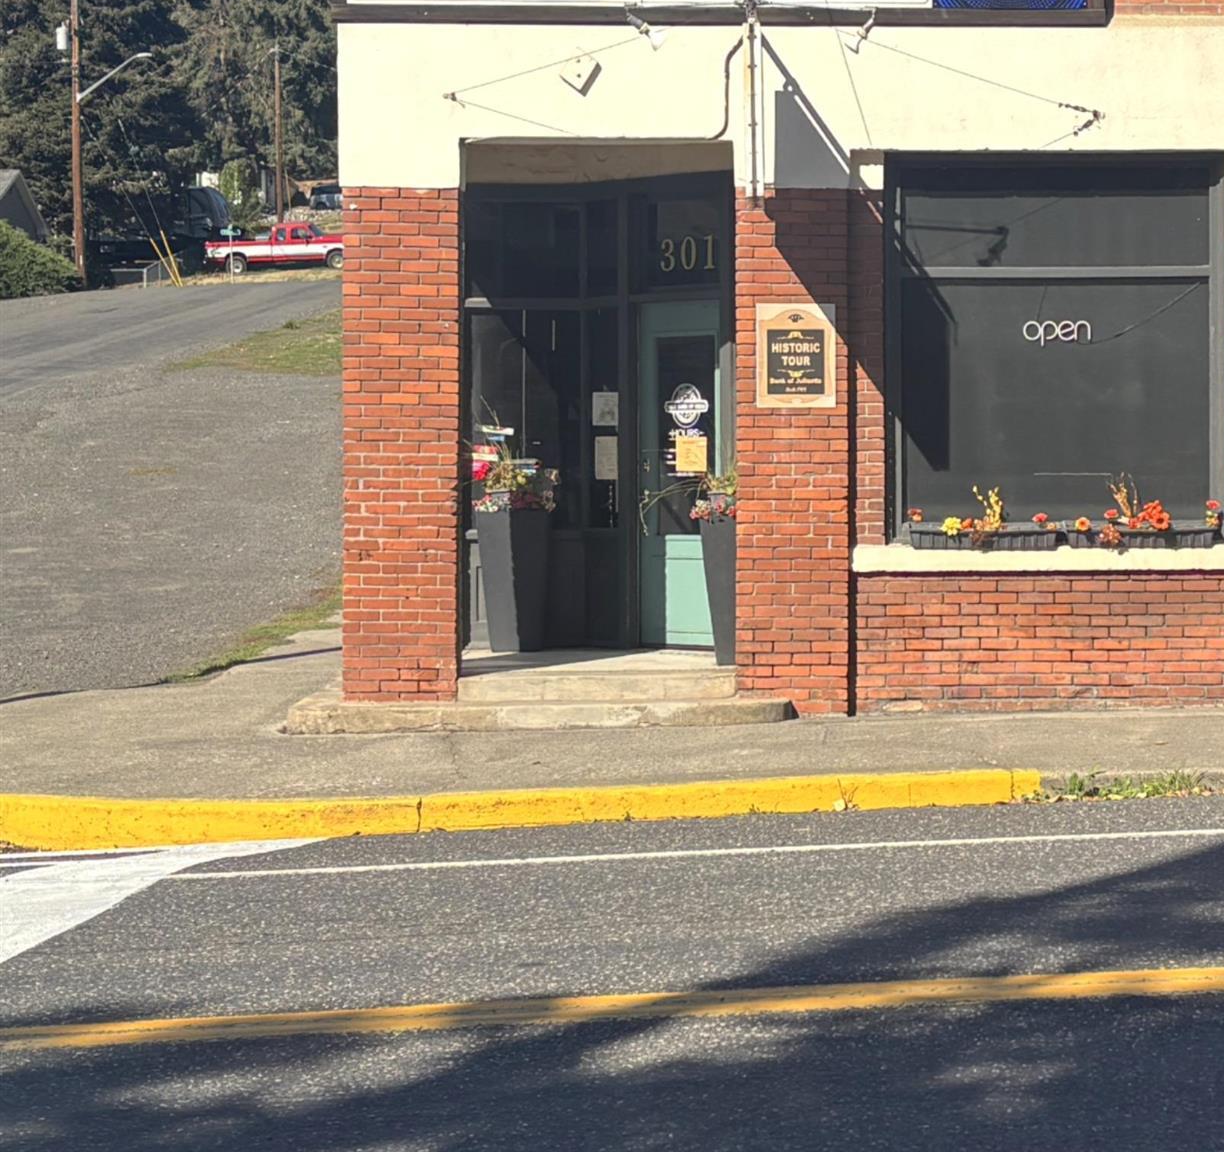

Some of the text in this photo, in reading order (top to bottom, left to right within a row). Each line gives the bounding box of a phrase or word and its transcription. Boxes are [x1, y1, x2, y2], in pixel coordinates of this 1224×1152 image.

[660, 234, 716, 272] 301
[1022, 320, 1092, 347] open
[771, 343, 820, 353] HISTORIC
[781, 356, 811, 366] TOUR
